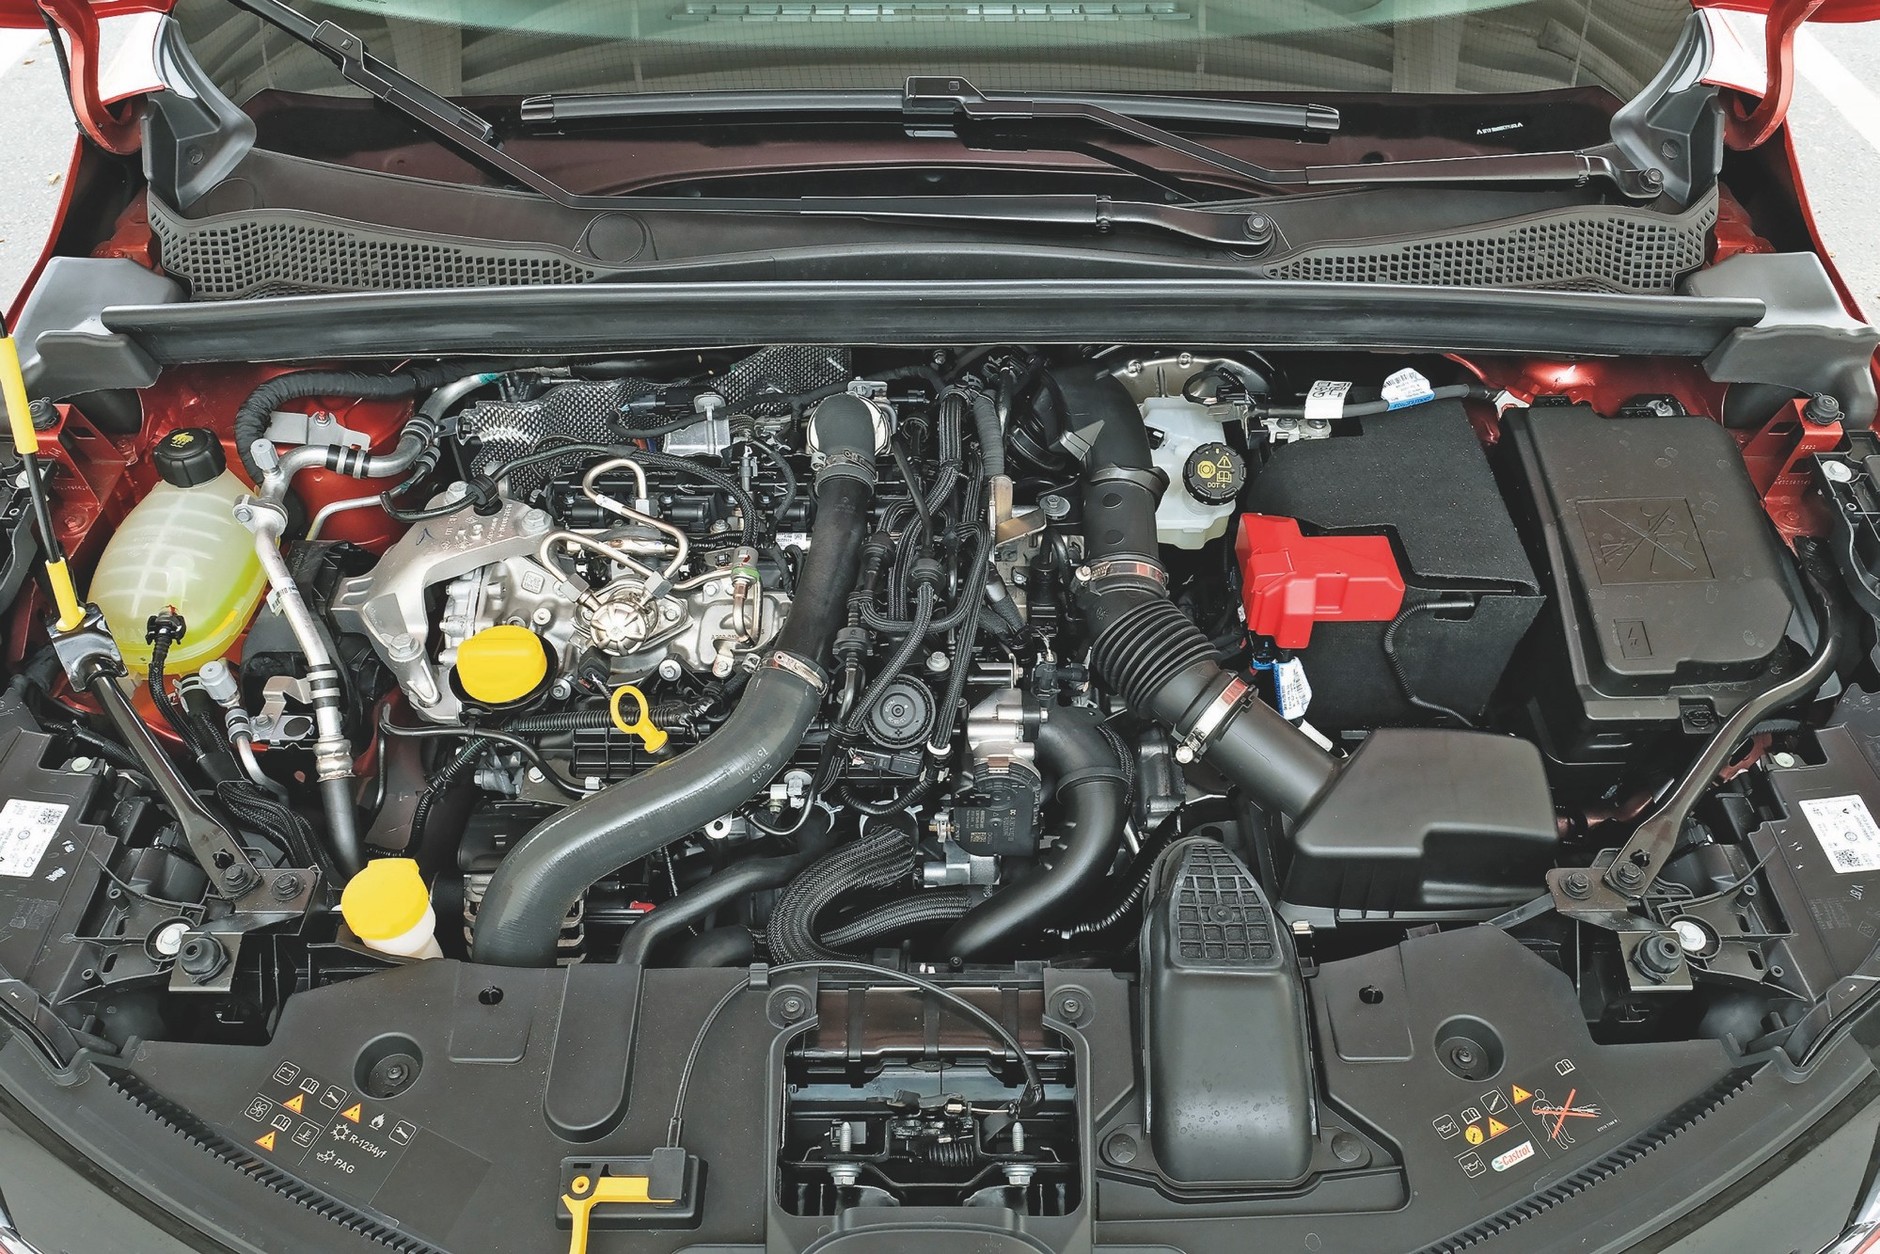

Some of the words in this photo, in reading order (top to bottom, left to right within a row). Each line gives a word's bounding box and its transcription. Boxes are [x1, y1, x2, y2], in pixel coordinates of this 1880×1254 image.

[348, 1134, 387, 1158] R-1234yf
[1502, 1144, 1531, 1166] Castrol
[333, 1158, 355, 1174] PAG
